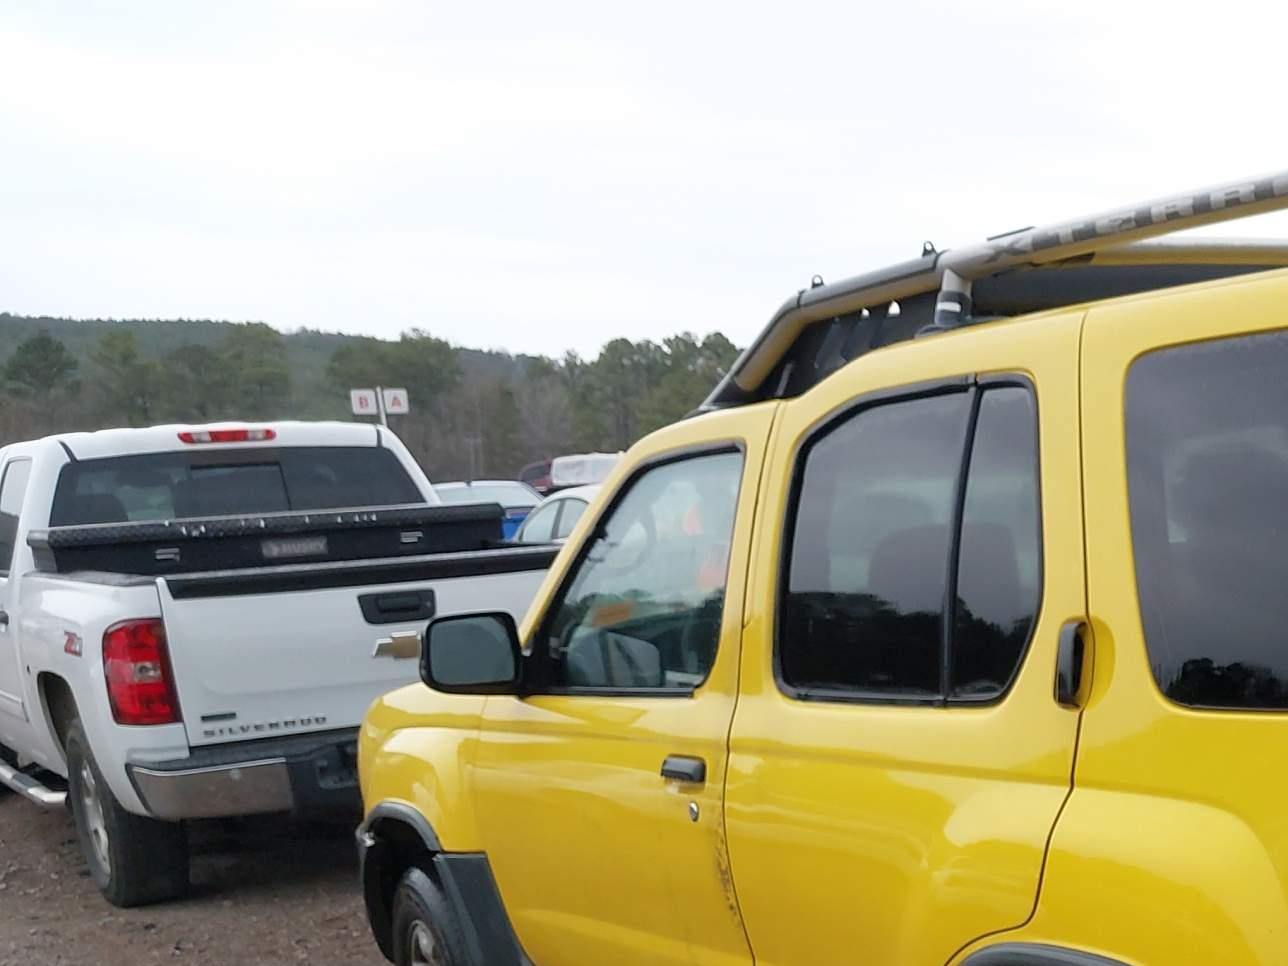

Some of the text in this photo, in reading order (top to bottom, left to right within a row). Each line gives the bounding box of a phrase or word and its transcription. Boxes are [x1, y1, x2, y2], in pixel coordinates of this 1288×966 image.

[359, 395, 370, 409] B
[391, 395, 402, 408] A
[202, 716, 327, 738] SILVERADO
